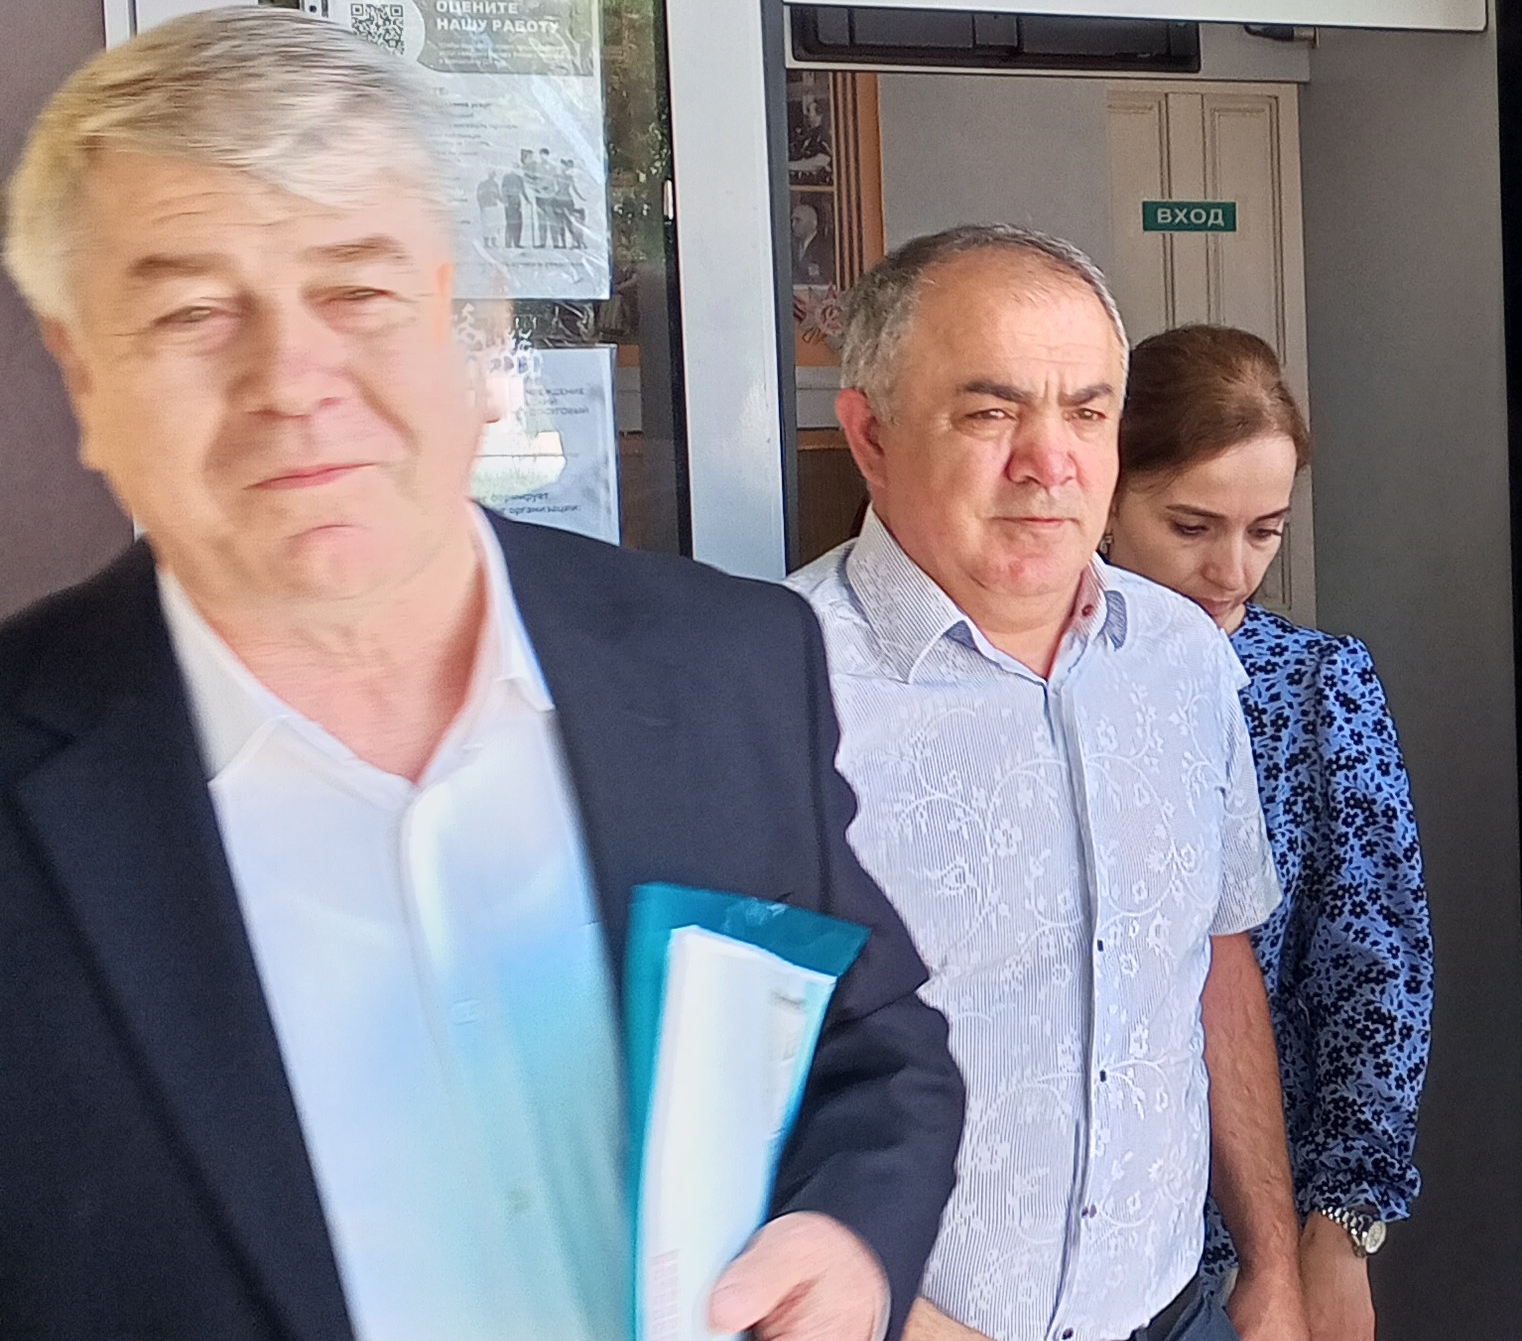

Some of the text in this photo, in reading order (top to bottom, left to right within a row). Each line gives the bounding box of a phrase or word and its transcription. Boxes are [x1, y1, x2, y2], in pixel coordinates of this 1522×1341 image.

[436, 0, 518, 16] ОЦЕНИТЕ
[436, 17, 559, 33] НАШУ РАБОТУ
[1157, 208, 1225, 227] ВХОД
